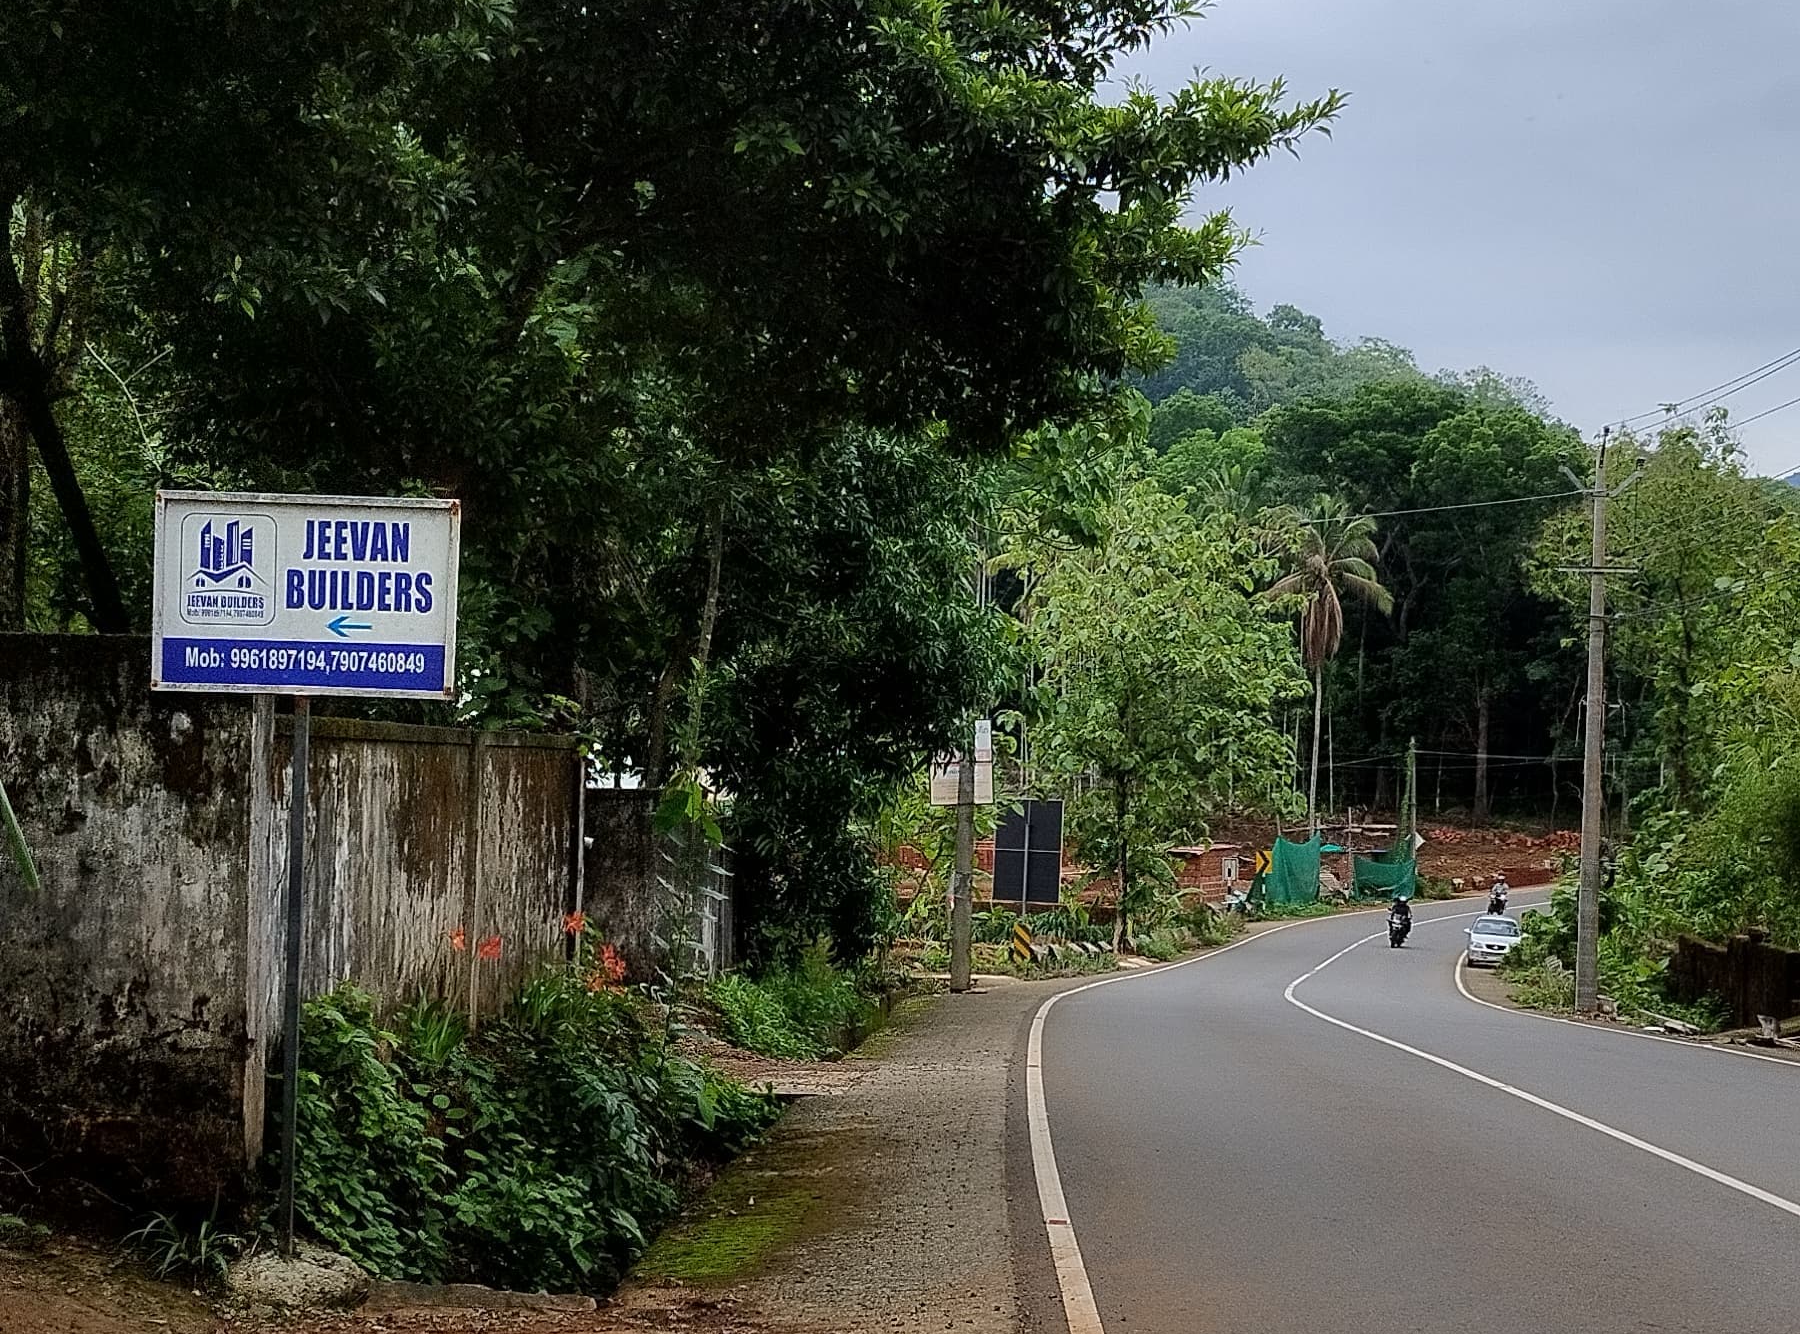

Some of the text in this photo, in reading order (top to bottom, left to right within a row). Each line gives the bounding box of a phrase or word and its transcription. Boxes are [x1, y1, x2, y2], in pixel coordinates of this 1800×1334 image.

[302, 519, 410, 563] JEEVAN
[187, 595, 265, 609] JEEVAN BUILDERS
[286, 569, 433, 613] BUILDERS
[185, 647, 425, 674] Mob: 9961897194,7907460849
